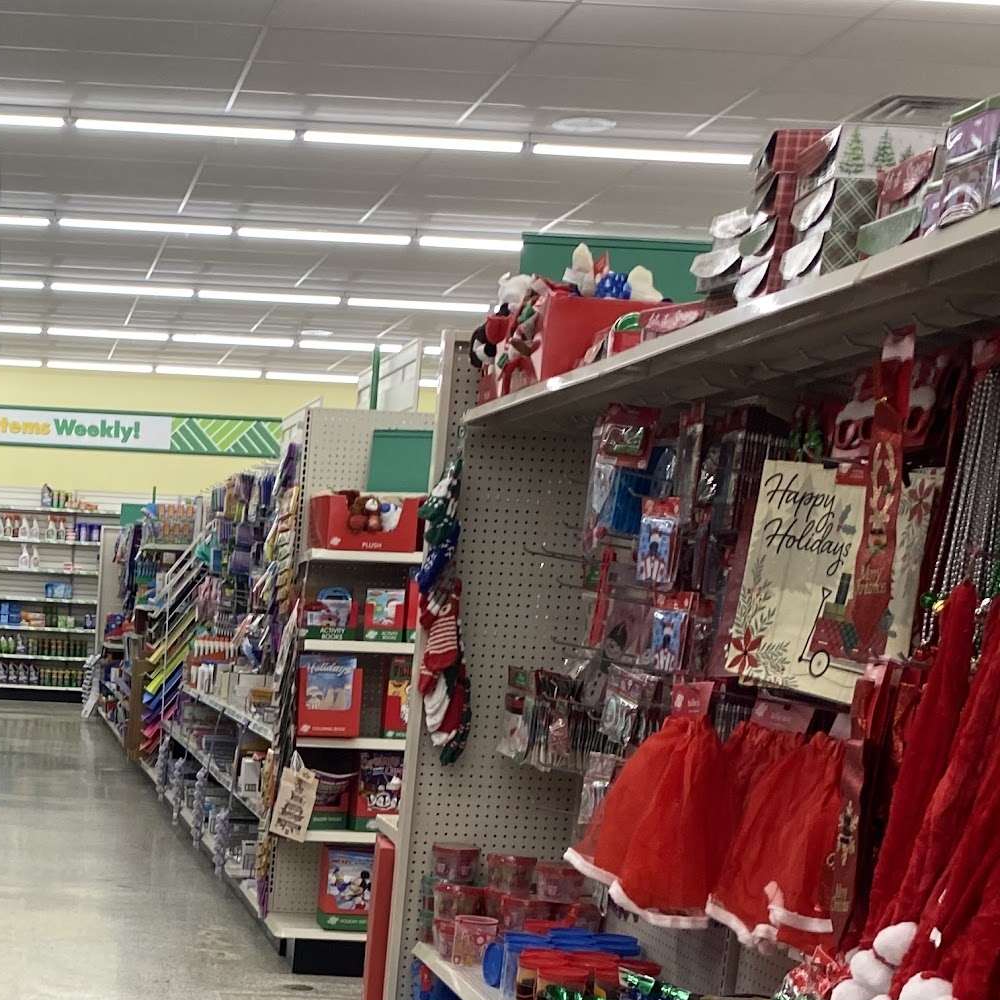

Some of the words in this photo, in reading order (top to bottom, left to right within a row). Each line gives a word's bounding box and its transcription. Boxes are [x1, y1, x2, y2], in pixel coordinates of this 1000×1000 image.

[53, 418, 141, 443] Weekly!
[764, 472, 836, 533] Happy
[361, 541, 383, 550] PLUSH
[763, 517, 852, 577] Holidays
[303, 661, 353, 677] Holidays
